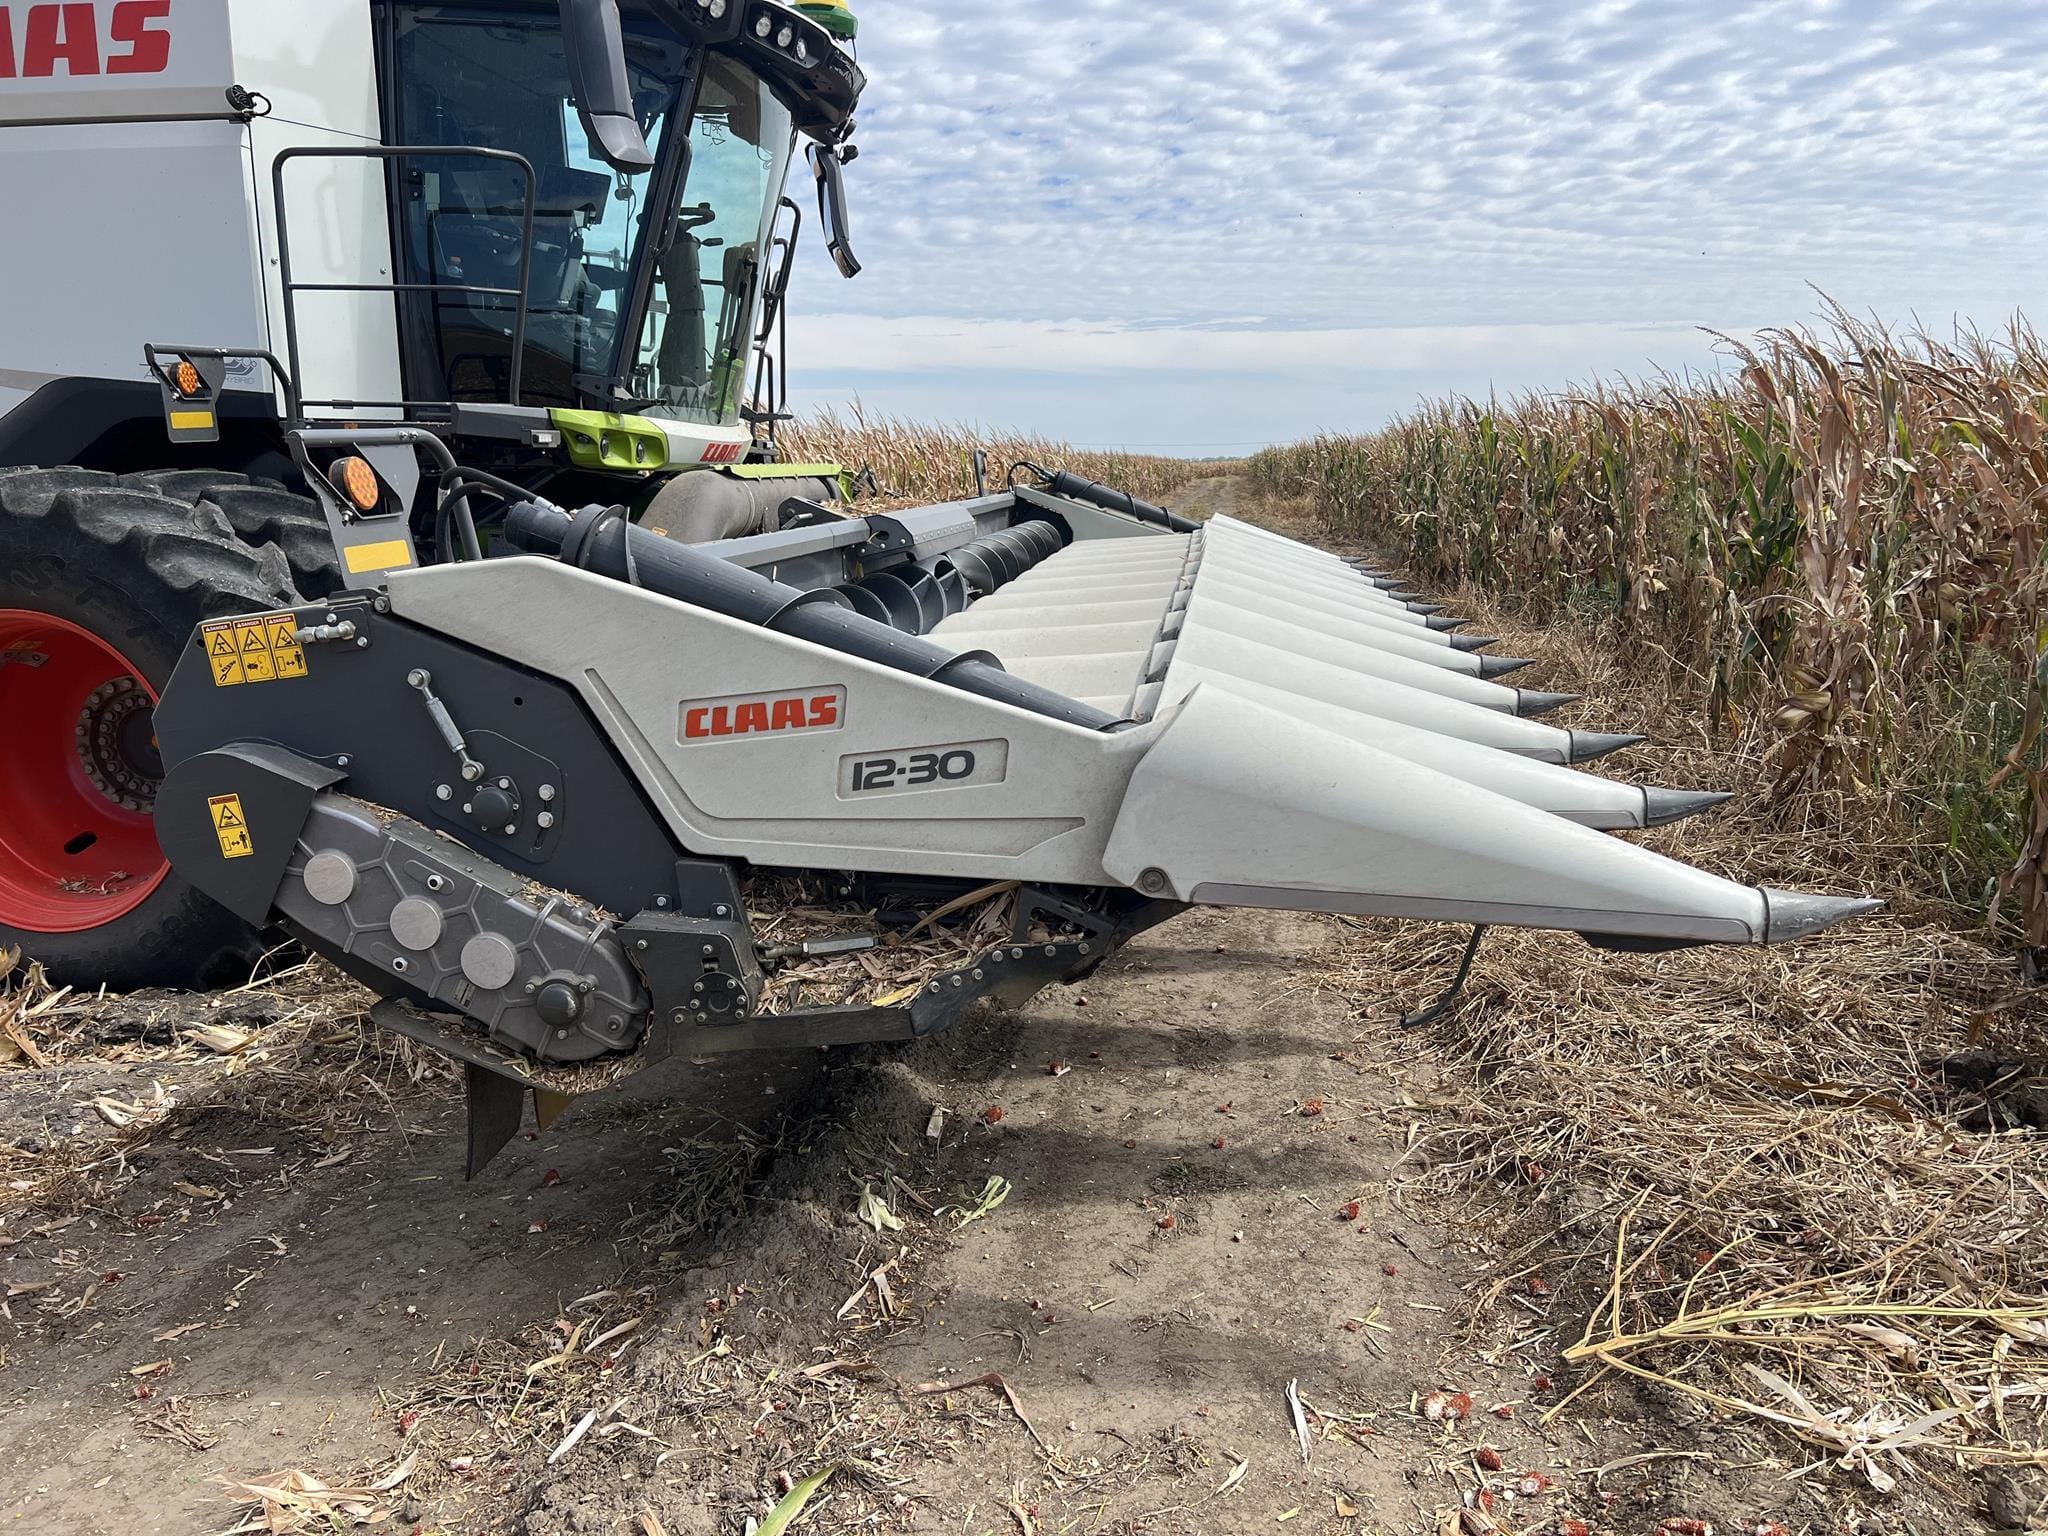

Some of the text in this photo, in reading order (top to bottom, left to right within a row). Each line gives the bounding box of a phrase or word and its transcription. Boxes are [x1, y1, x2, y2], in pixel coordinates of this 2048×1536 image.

[0, 0, 170, 78] AS
[700, 443, 743, 462] CLAAS
[685, 695, 837, 738] CLAAS
